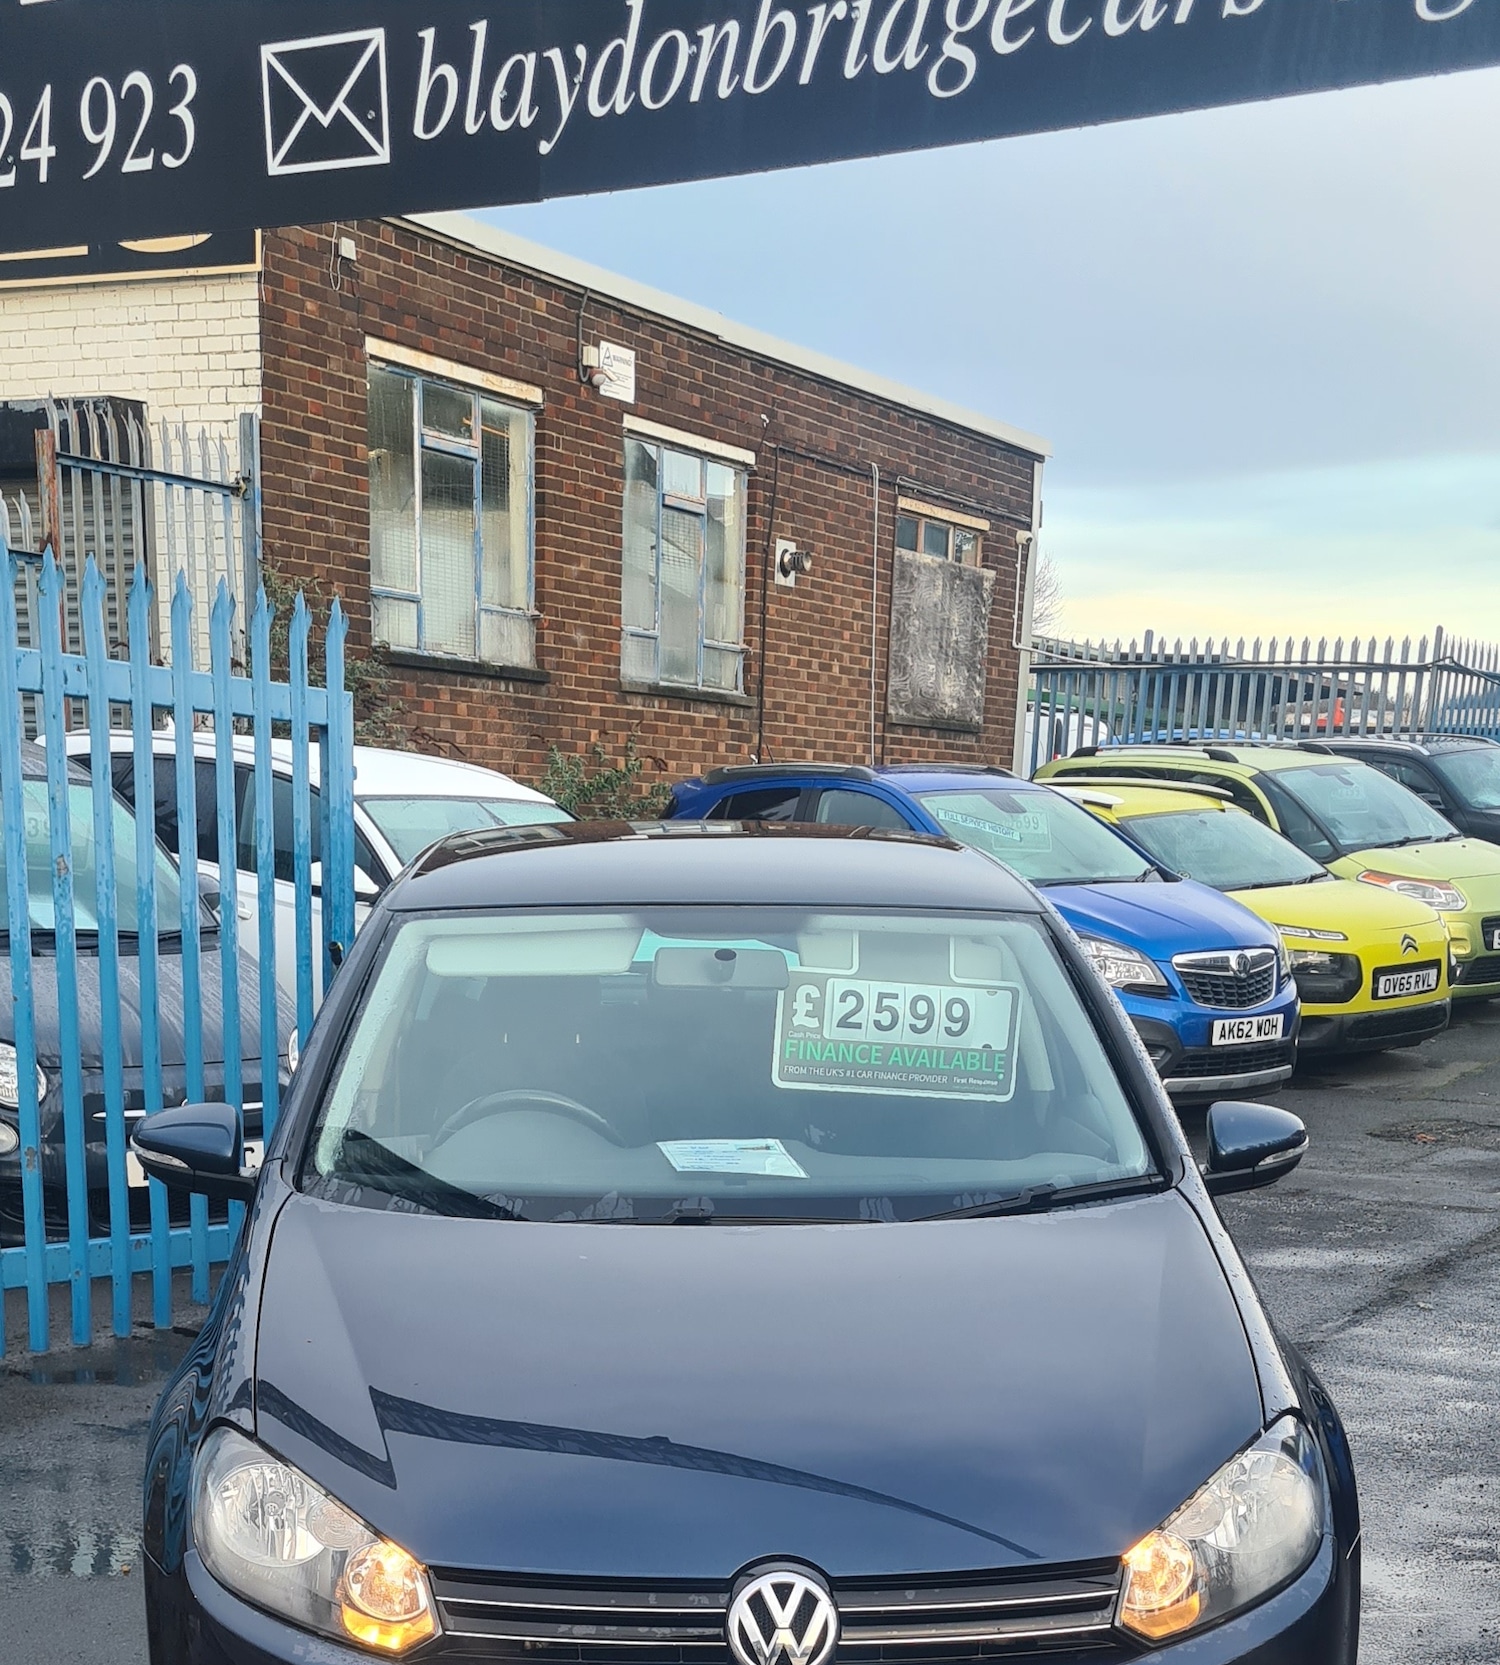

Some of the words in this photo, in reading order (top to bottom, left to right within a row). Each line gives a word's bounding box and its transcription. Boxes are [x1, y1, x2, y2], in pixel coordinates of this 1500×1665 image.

[80, 63, 197, 180] 923
[1383, 975, 1412, 993] OV65
[1414, 972, 1432, 990] RVL
[836, 989, 970, 1037] 2599
[1219, 1020, 1253, 1041] AK62
[1256, 1017, 1279, 1037] WOH
[785, 1039, 883, 1065] FINANCE
[888, 1049, 1006, 1073] AVAILABLE
[783, 1065, 807, 1075] FROM
[809, 1067, 825, 1076] THE
[856, 1070, 873, 1079] CAR
[873, 1071, 908, 1081] FINANCE
[908, 1073, 948, 1084] PROVIDER
